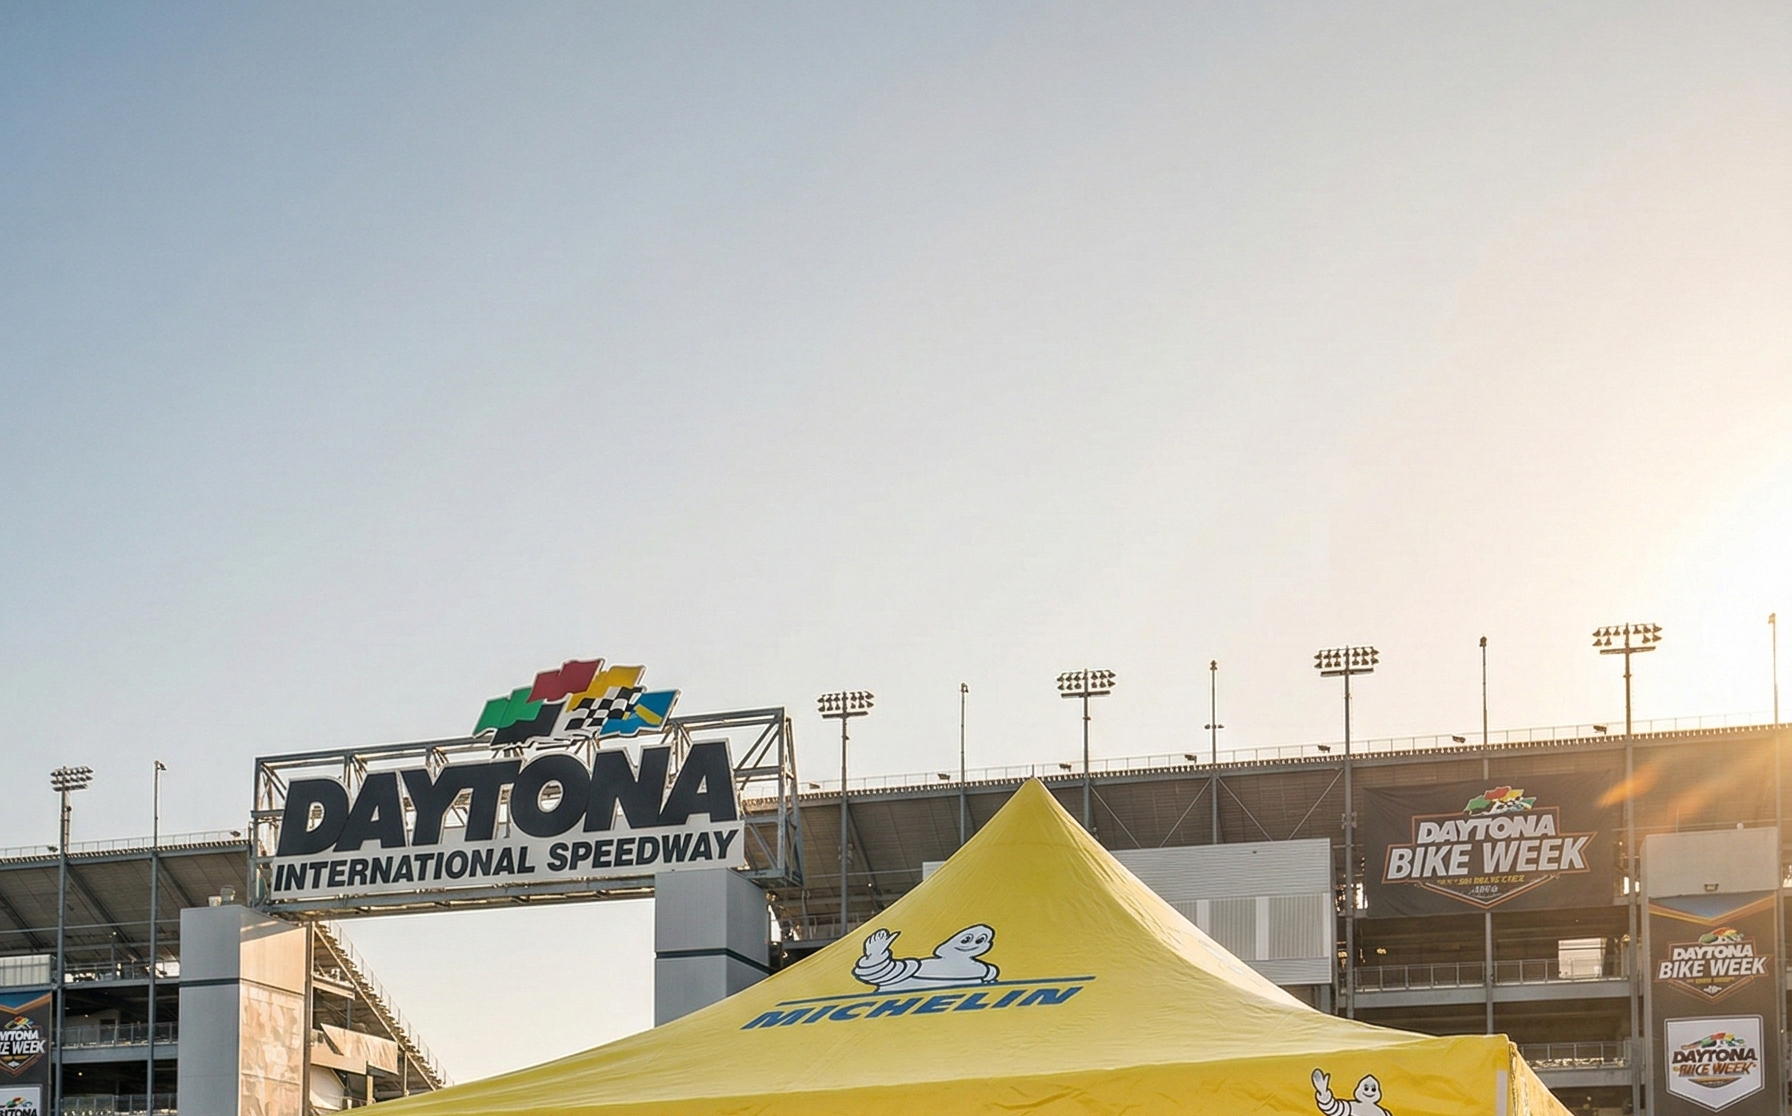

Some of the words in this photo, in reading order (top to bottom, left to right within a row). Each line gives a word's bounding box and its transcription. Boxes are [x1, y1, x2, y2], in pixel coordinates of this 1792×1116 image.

[276, 741, 740, 857] DAYTONA
[1417, 814, 1556, 844] DAYTONA
[273, 846, 536, 892] INTERNATIONAL
[547, 829, 739, 873] SPEEDWAY
[1387, 843, 1472, 880] BIKE
[1483, 836, 1592, 873] WEEK
[1658, 960, 1705, 979] BIKE
[1709, 956, 1767, 976] WEEK
[1672, 944, 1753, 961] DAYTONA
[740, 986, 1084, 1030] MICHELIN
[1672, 1048, 1758, 1064] DAYTONA
